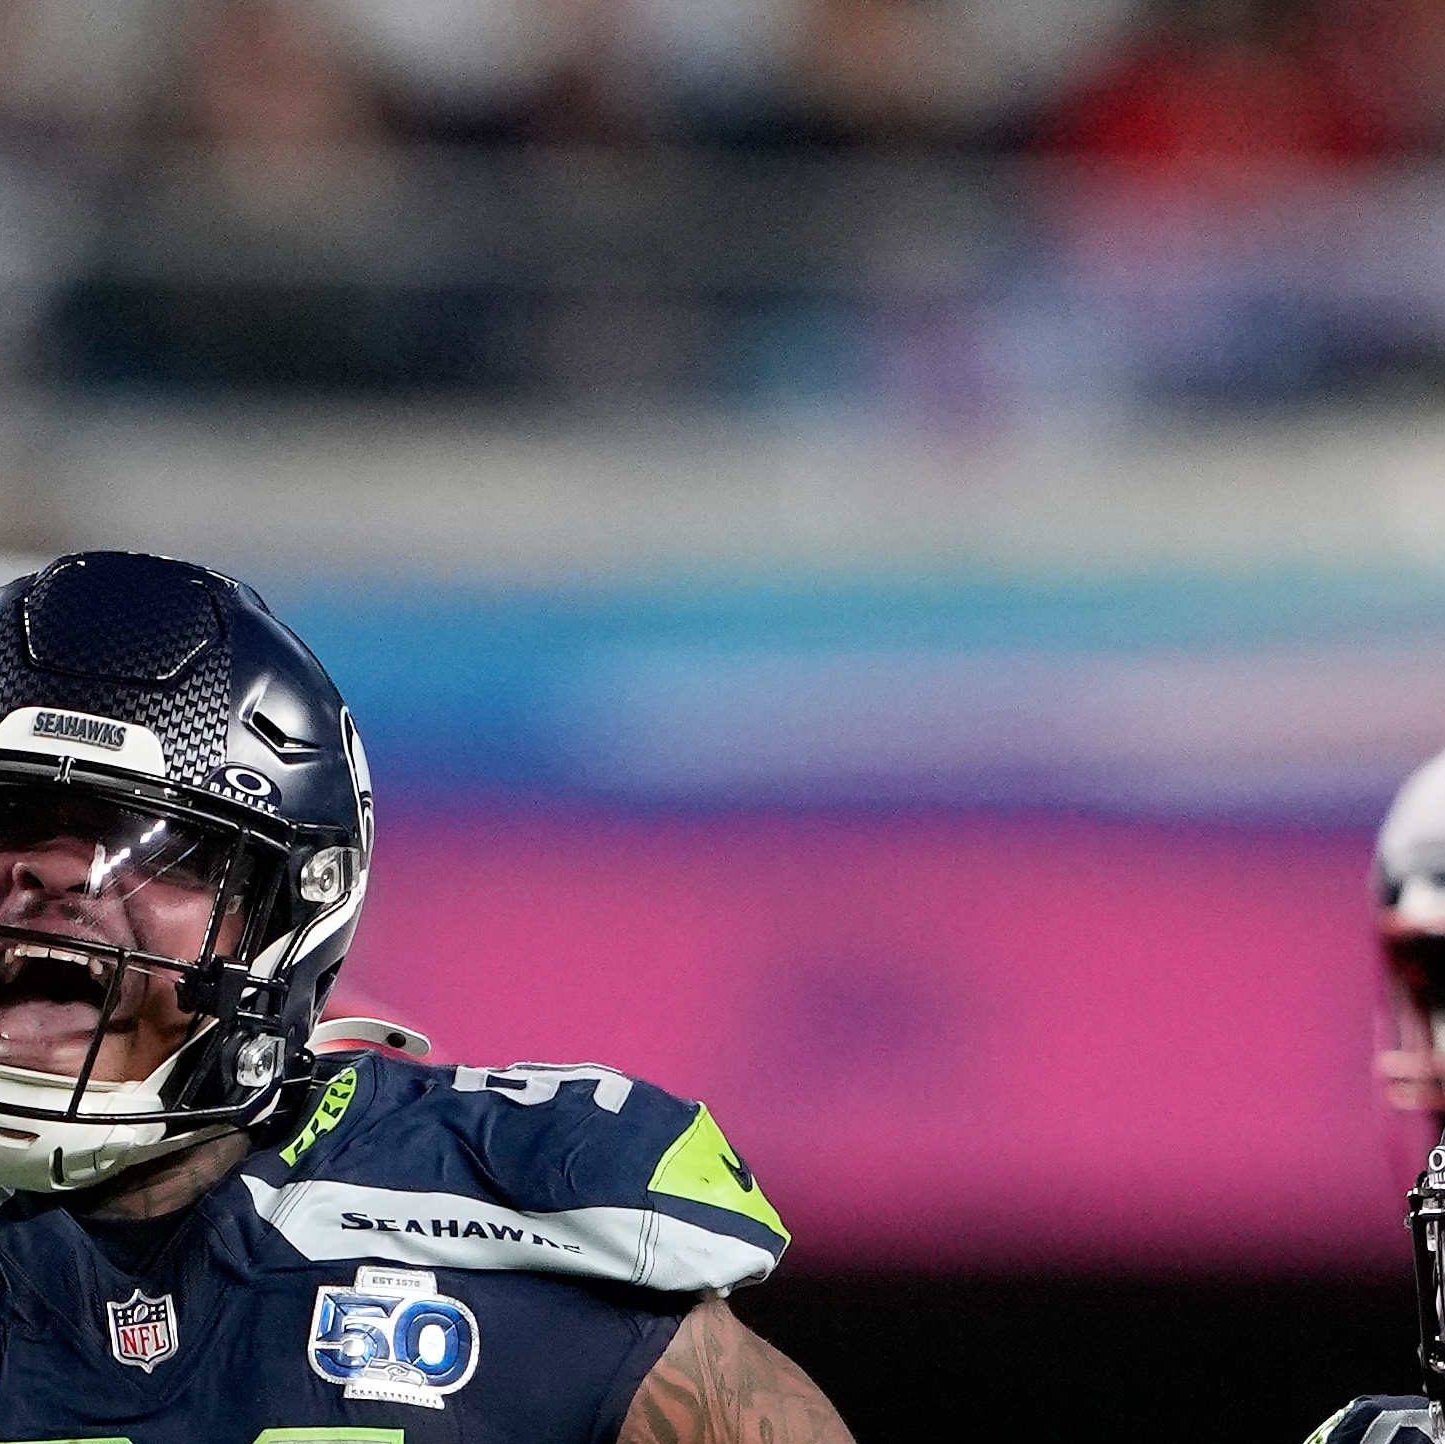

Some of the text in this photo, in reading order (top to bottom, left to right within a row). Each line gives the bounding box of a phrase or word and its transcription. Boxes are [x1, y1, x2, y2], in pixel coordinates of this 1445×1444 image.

[33, 711, 127, 748] SEAHAWKS
[121, 1324, 166, 1357] NFL
[315, 1292, 473, 1388] 50
